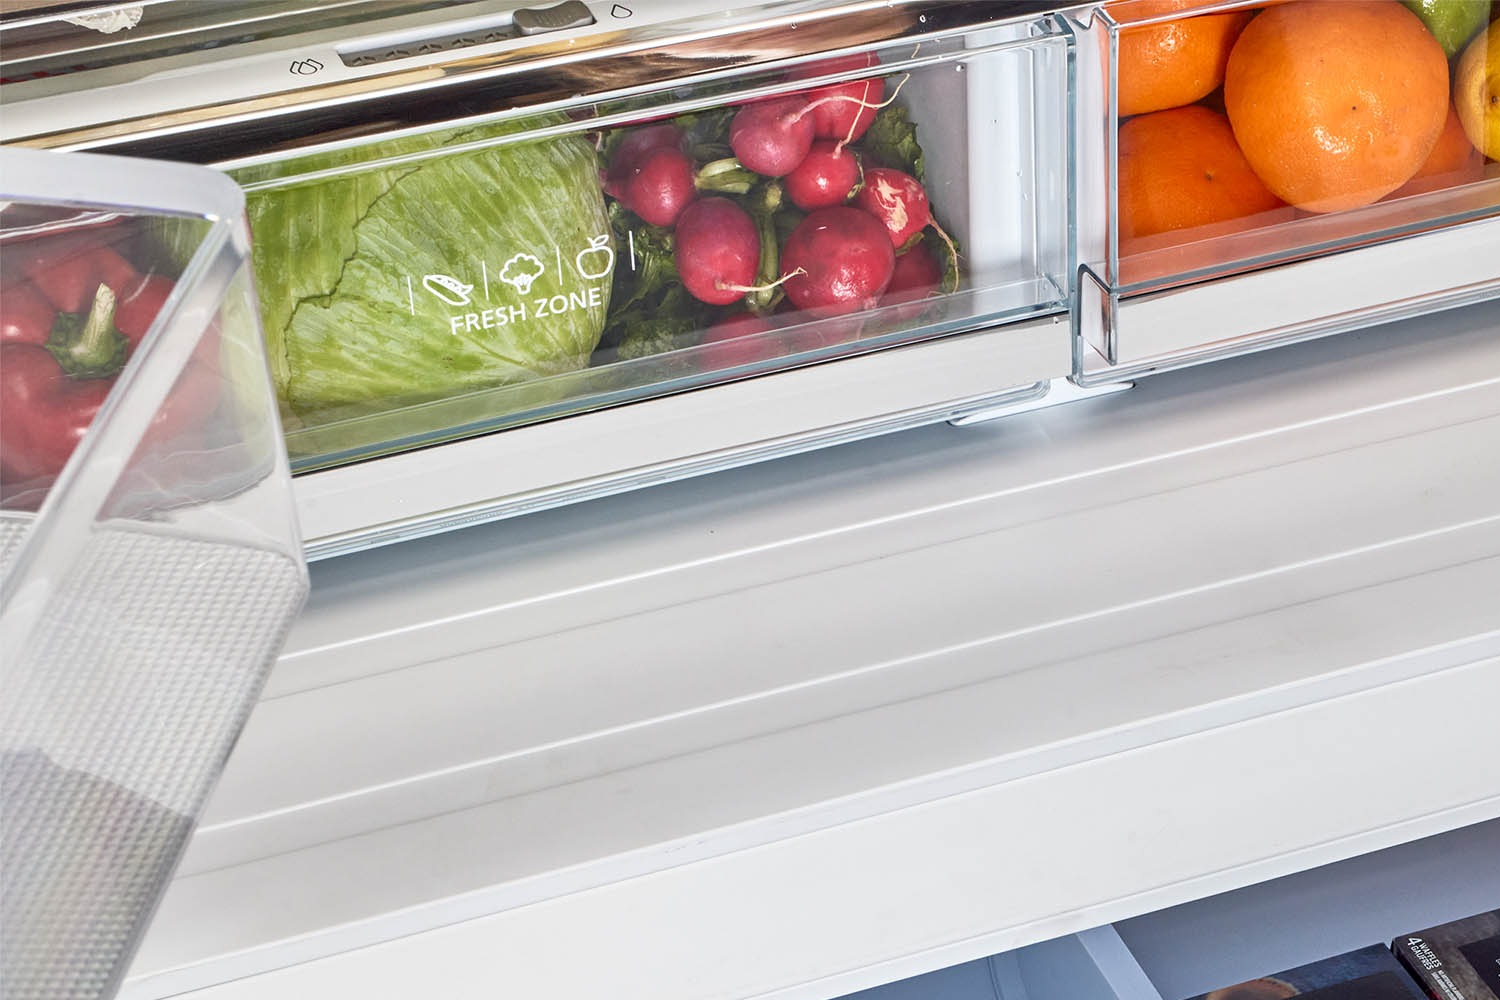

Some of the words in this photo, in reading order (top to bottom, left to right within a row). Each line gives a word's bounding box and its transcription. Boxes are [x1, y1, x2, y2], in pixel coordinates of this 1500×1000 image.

[450, 303, 526, 335] FRESH
[534, 287, 602, 318] ZONE
[1408, 937, 1423, 946] 4
[1419, 942, 1442, 968] WAFFLES
[1411, 945, 1434, 970] GAUFRES
